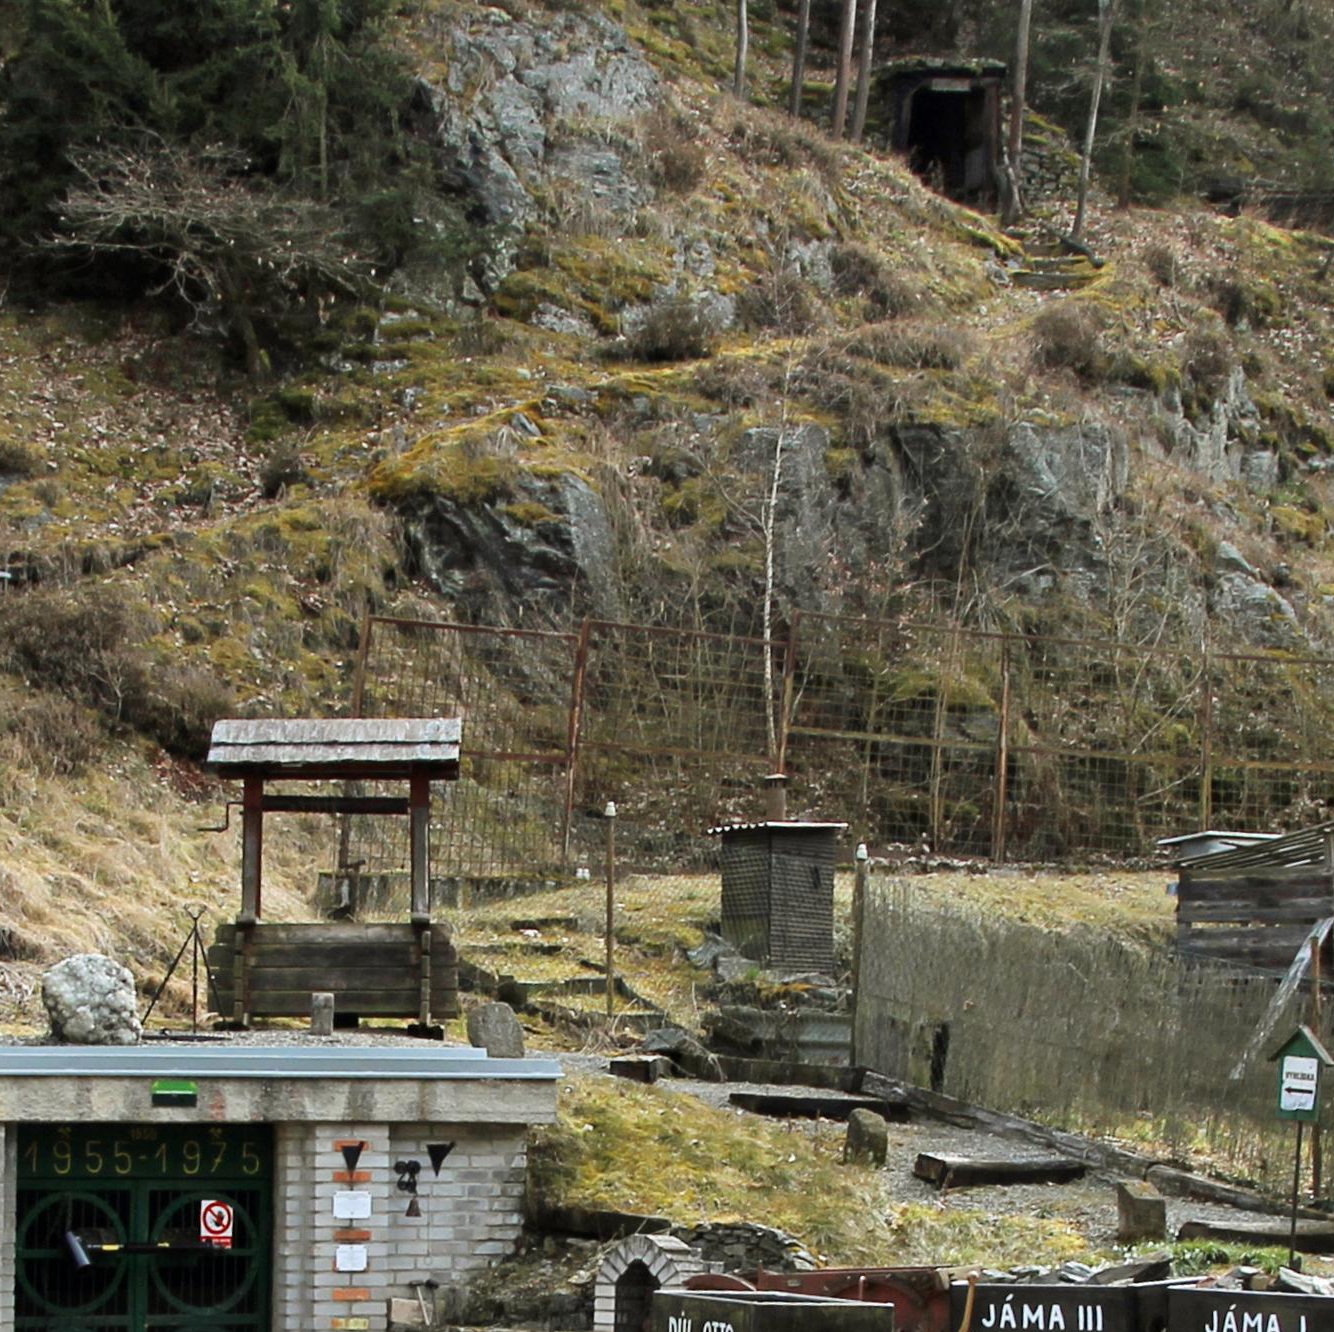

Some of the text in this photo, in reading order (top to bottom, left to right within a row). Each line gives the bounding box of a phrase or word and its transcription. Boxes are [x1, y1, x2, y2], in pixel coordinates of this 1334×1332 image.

[24, 1140, 260, 1175] 1955-1975
[981, 1293, 1104, 1331] JÁMA III
